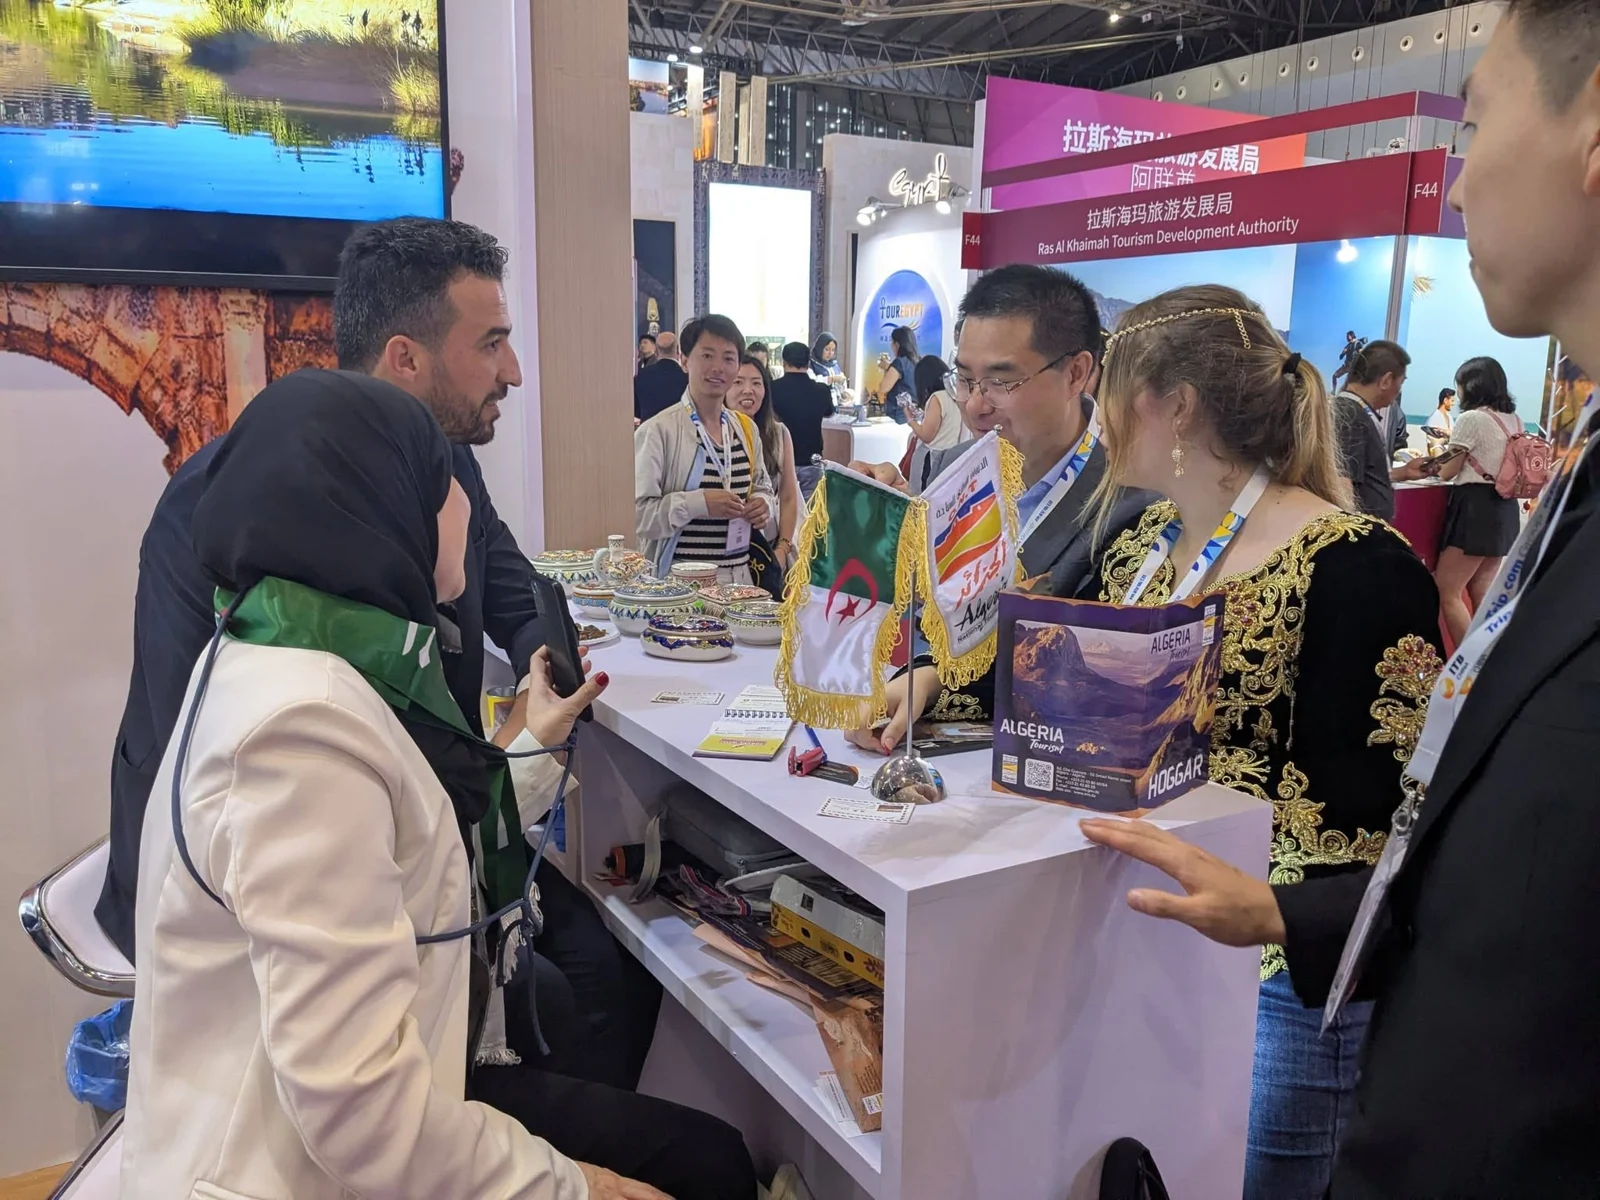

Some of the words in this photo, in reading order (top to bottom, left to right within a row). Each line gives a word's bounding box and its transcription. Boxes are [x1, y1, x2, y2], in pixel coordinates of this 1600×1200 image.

[1414, 181, 1438, 199] F44
[1087, 192, 1233, 230] 拉斯海玛旅游发展局
[965, 234, 980, 246] F44
[1038, 243, 1054, 255] Ras
[1055, 240, 1065, 254] Al
[1066, 235, 1109, 253] Khaimah
[1112, 232, 1154, 248] Tourism
[1156, 222, 1235, 244] Development
[1237, 216, 1300, 235] Authority
[1150, 628, 1191, 654] ALGERIA
[1449, 654, 1465, 675] ITB
[1000, 718, 1064, 743] ALGERIA
[1029, 738, 1065, 754] Tourism
[1147, 753, 1203, 800] HOGGAR
